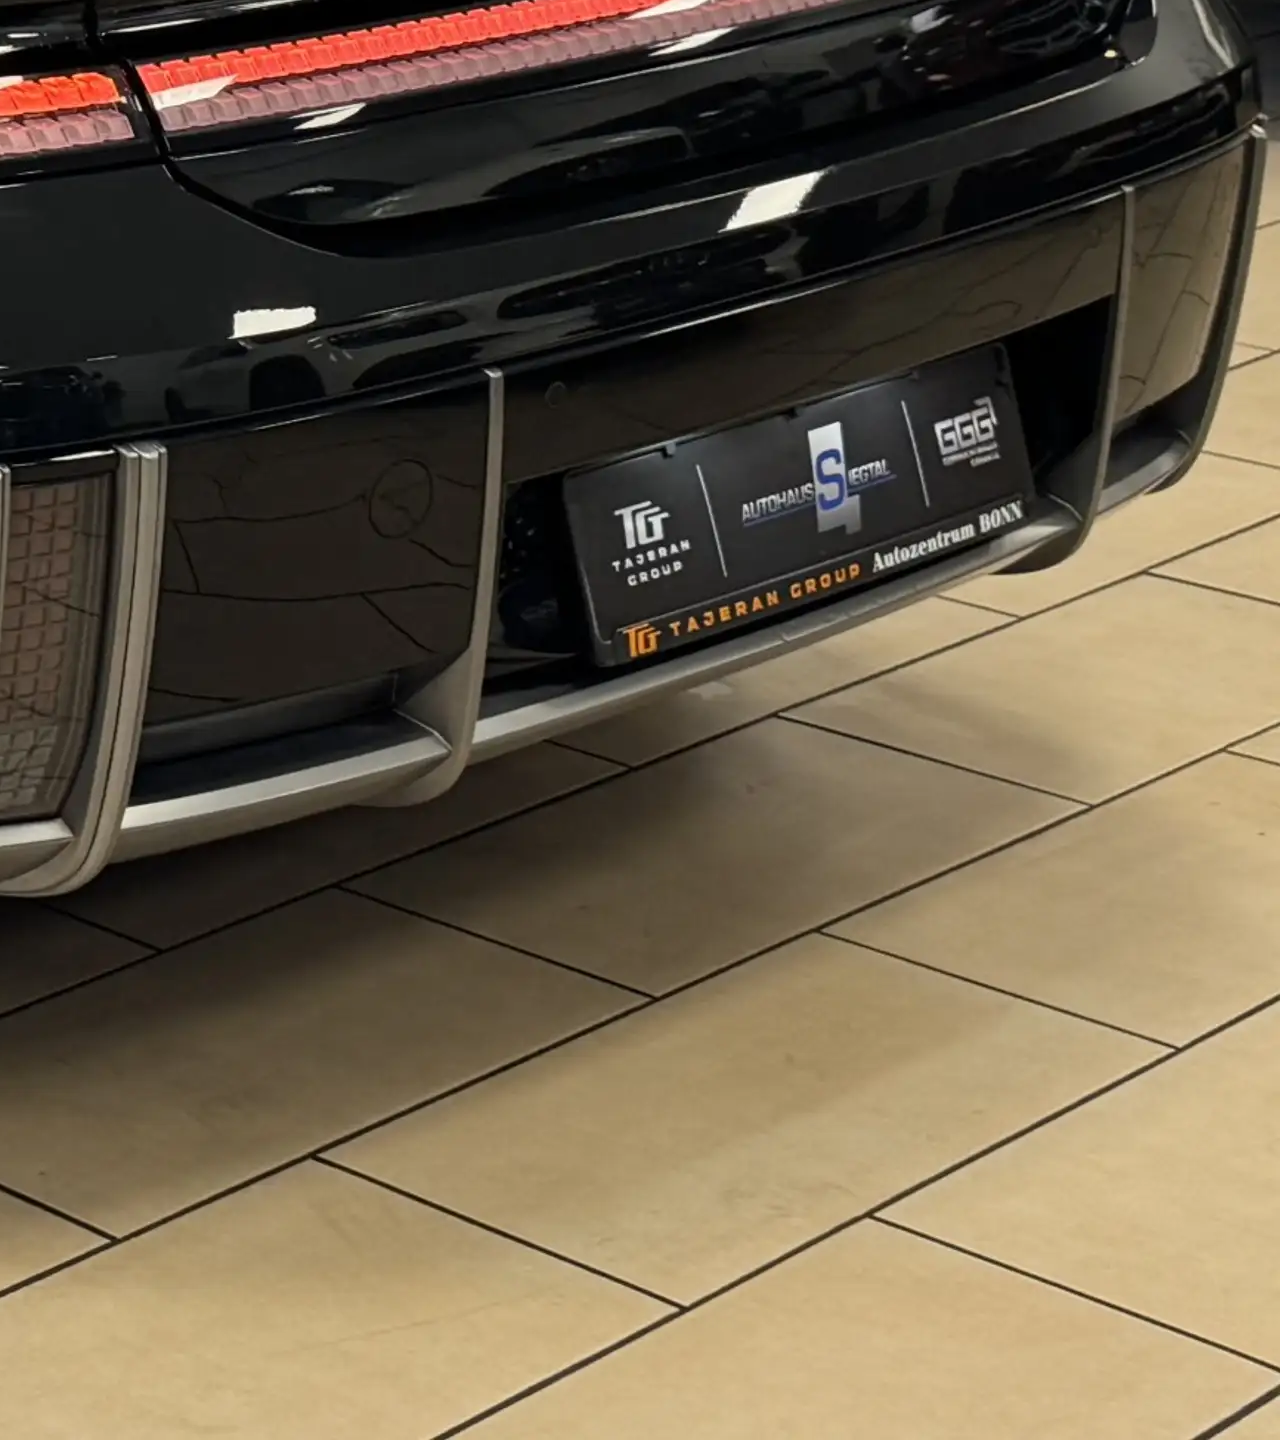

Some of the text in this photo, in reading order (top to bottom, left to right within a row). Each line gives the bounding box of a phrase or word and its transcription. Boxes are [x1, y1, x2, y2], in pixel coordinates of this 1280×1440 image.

[741, 482, 815, 522] AUTOHAUS
[611, 539, 692, 573] TAJERAN
[626, 560, 684, 587] GROUP
[669, 589, 780, 637] TAJERAN
[790, 563, 861, 599] GROUP
[872, 522, 977, 574] Autozentrum
[977, 499, 1024, 534] BONN
